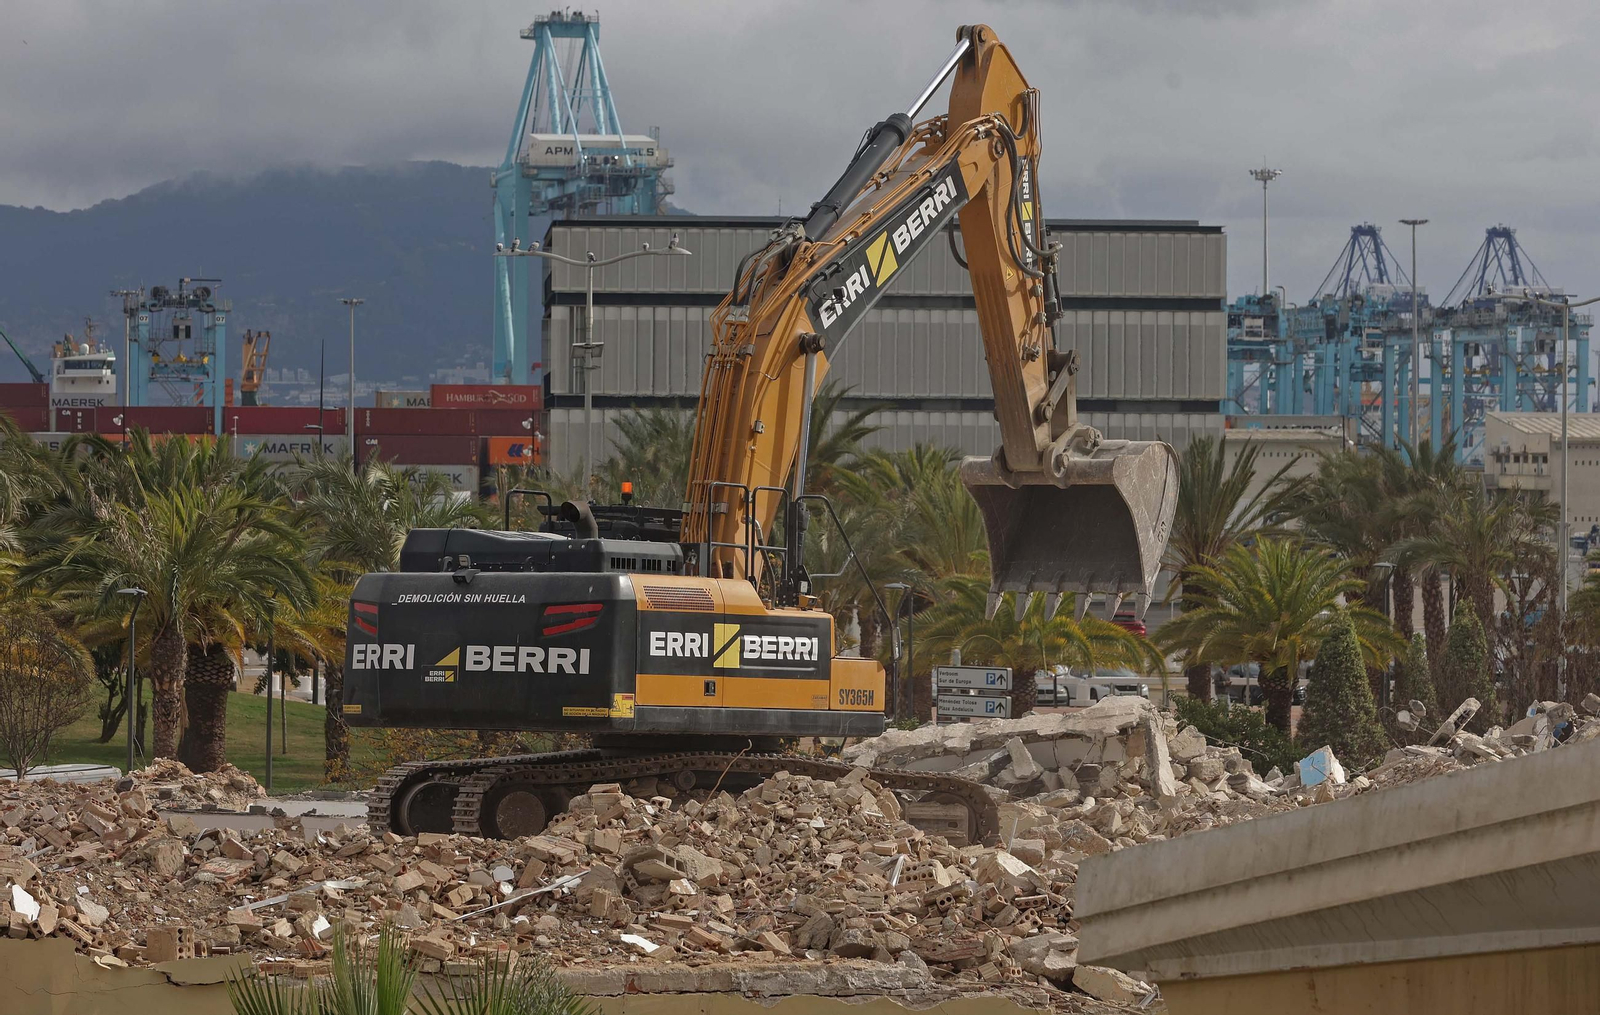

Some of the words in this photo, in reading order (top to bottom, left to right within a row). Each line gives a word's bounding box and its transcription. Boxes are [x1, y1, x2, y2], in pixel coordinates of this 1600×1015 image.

[545, 146, 573, 155] APM
[818, 264, 871, 330] ERRI
[892, 175, 958, 255] BERRI
[51, 398, 104, 407] MAERSK
[263, 443, 334, 454] MAERK
[463, 593, 482, 603] SIN
[483, 593, 526, 604] HUELLA
[649, 631, 709, 658] ERRI
[743, 634, 819, 661] BERRI
[352, 643, 415, 670] ERRI
[465, 645, 590, 675] BERRI
[838, 688, 874, 706] SY365H
